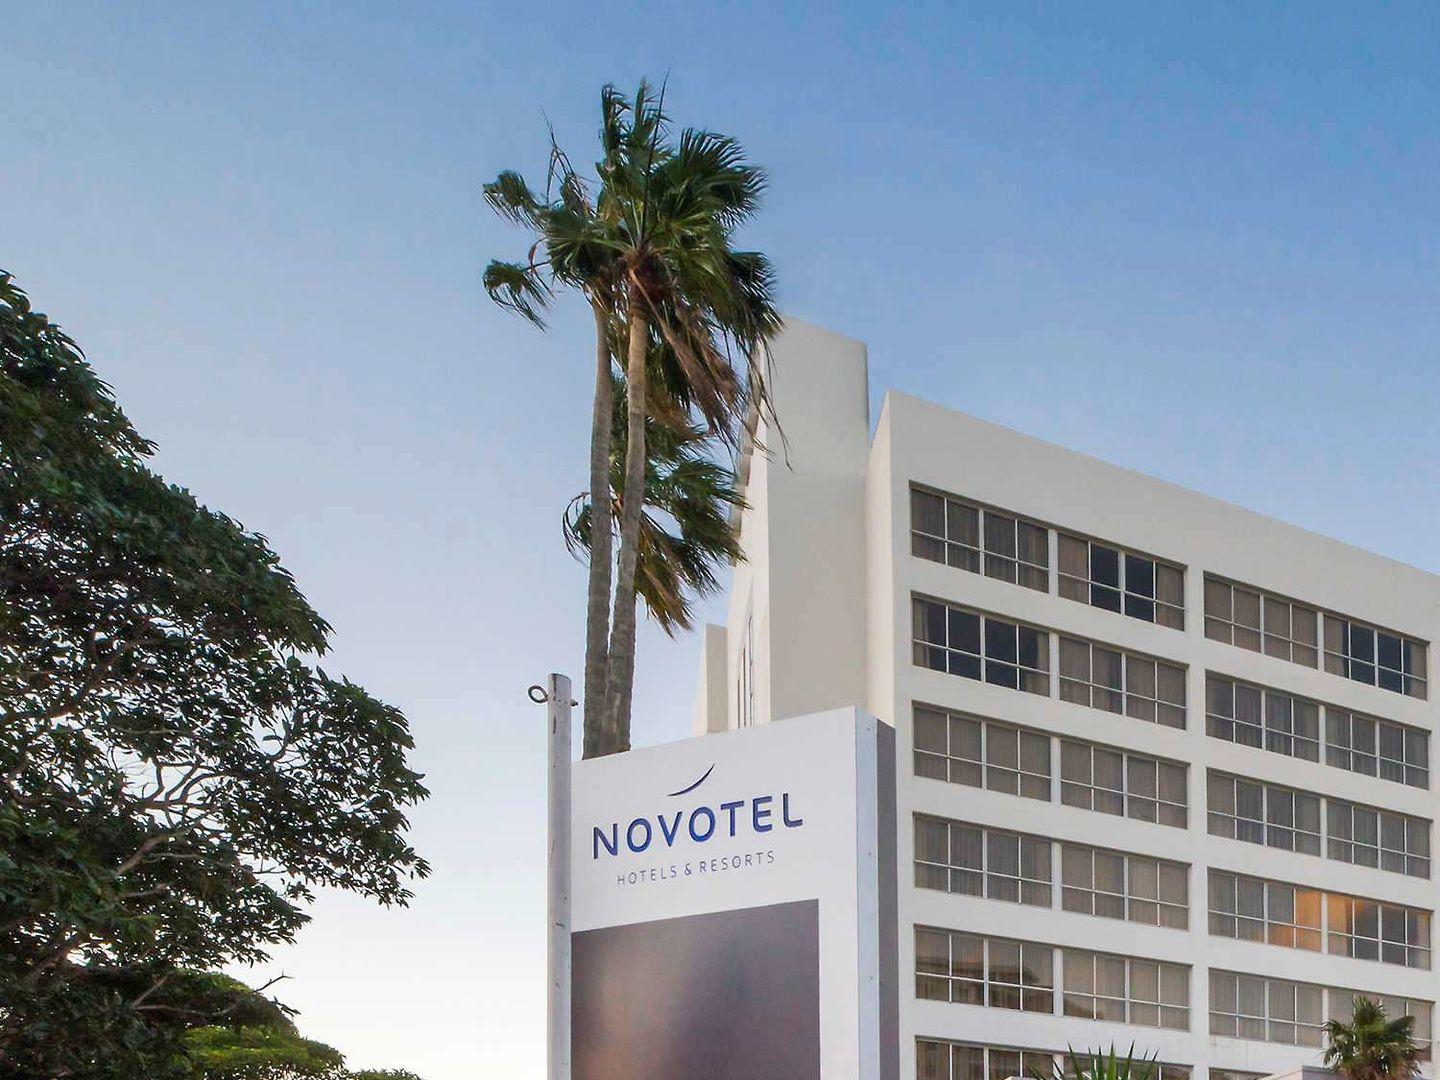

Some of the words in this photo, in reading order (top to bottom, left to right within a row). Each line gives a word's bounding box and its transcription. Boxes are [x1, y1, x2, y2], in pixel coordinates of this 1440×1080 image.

[593, 793, 803, 859] NOVOTEL
[617, 864, 677, 886] HOTELS
[684, 864, 692, 877] &
[700, 850, 775, 873] RESORTS
